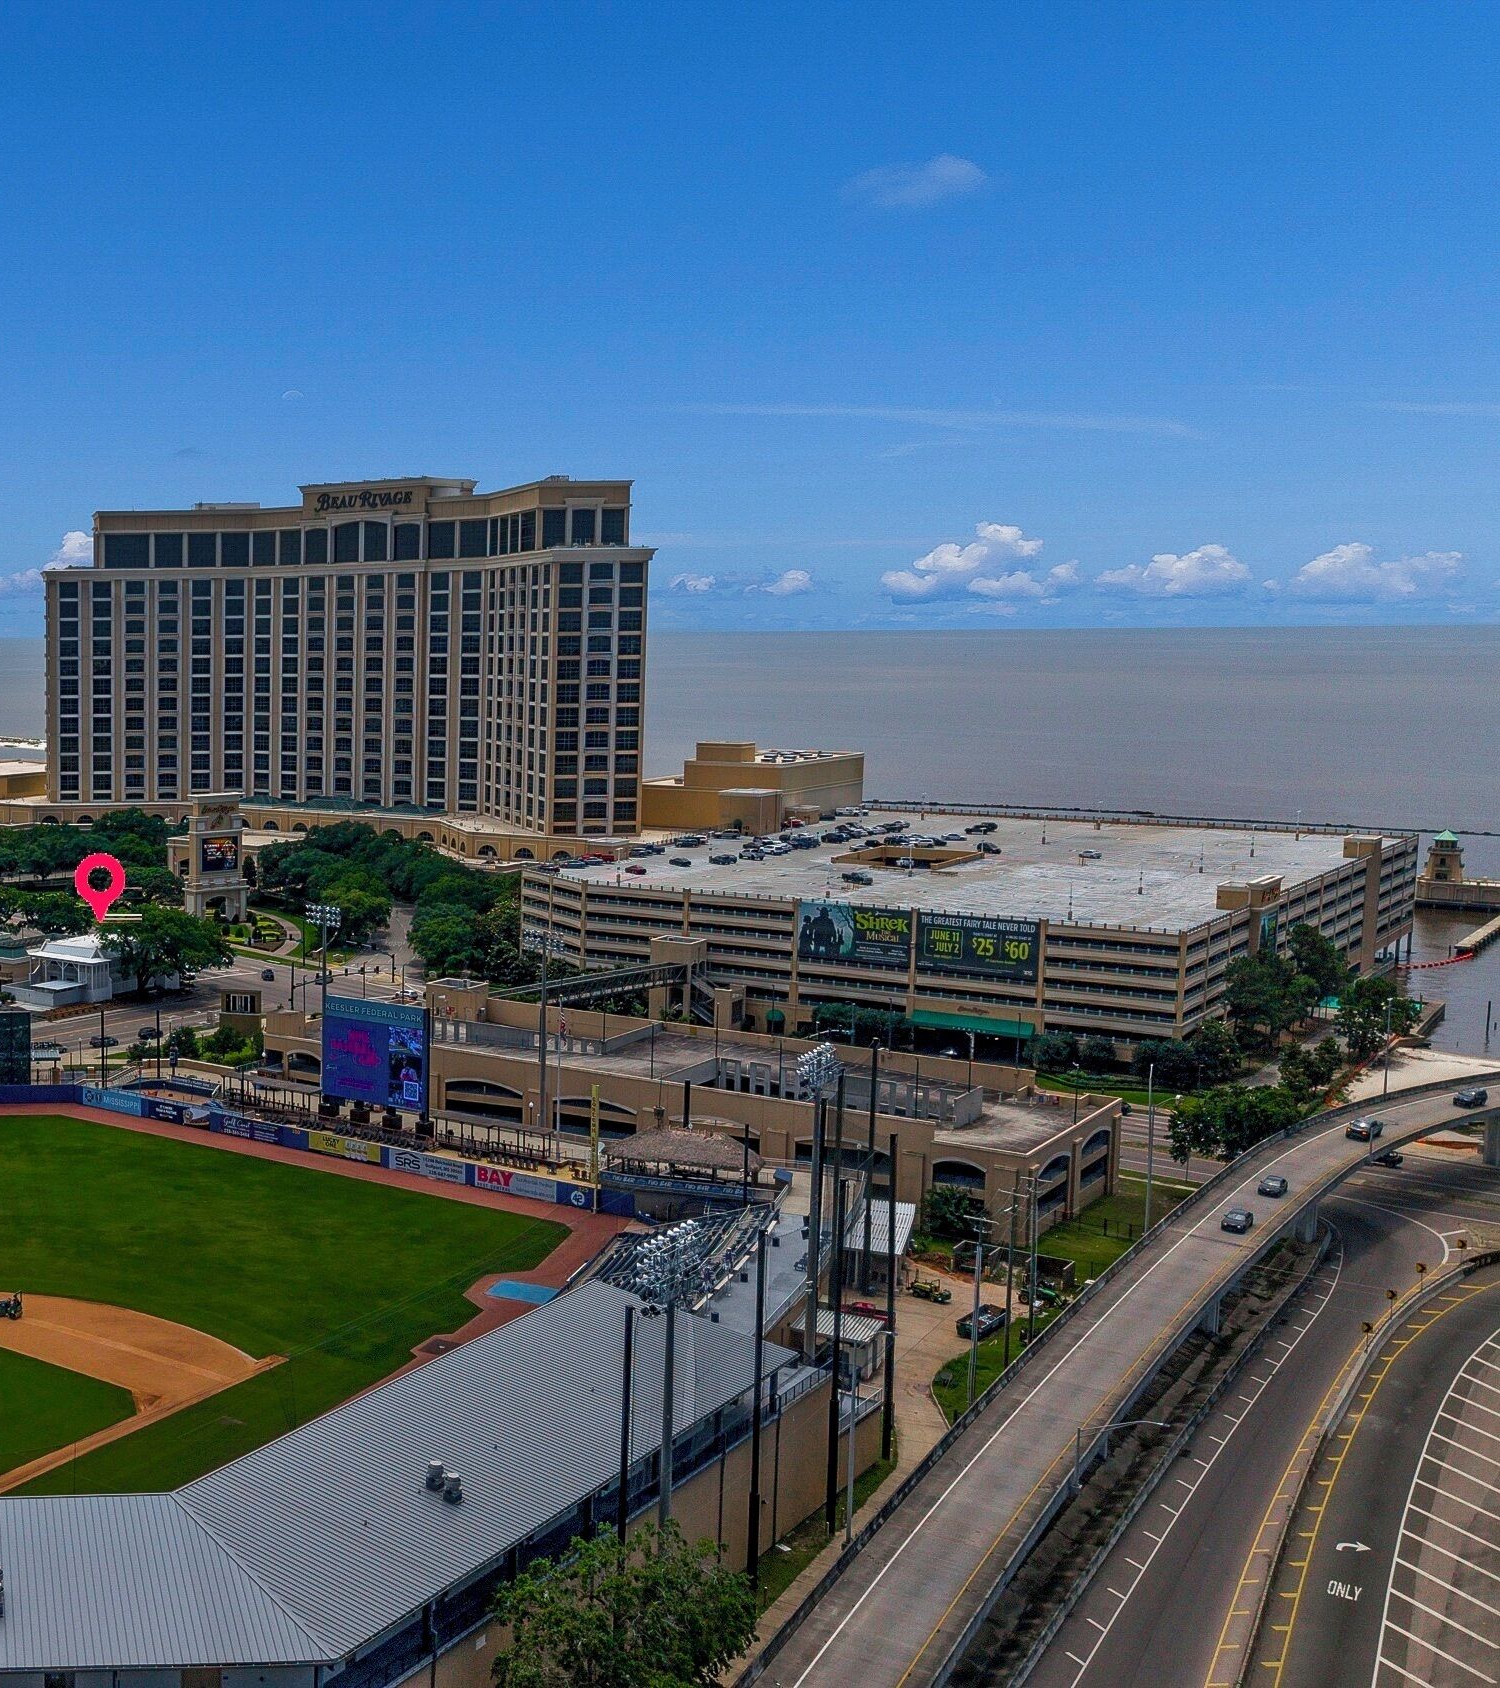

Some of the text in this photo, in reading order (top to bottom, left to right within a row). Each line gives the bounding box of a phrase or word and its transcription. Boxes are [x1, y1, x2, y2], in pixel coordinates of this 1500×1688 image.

[314, 489, 413, 512] BEAU RIVAGE
[855, 911, 909, 933] SHREK
[921, 915, 1036, 933] THE GREATEST FAIRY TALE NEVER TOLD
[930, 930, 950, 941] JUNE
[953, 931, 960, 942] 11
[935, 942, 953, 953] JULY
[954, 943, 959, 954] 2
[325, 1003, 422, 1022] KEESLER FEDERAL PARK
[103, 1095, 140, 1110] MISSISSIPPI
[322, 1135, 340, 1144] LUCKY
[325, 1140, 337, 1149] ONE
[394, 1155, 420, 1170] SRS
[477, 1166, 514, 1187] BAY
[1326, 1580, 1363, 1602] ONLY
